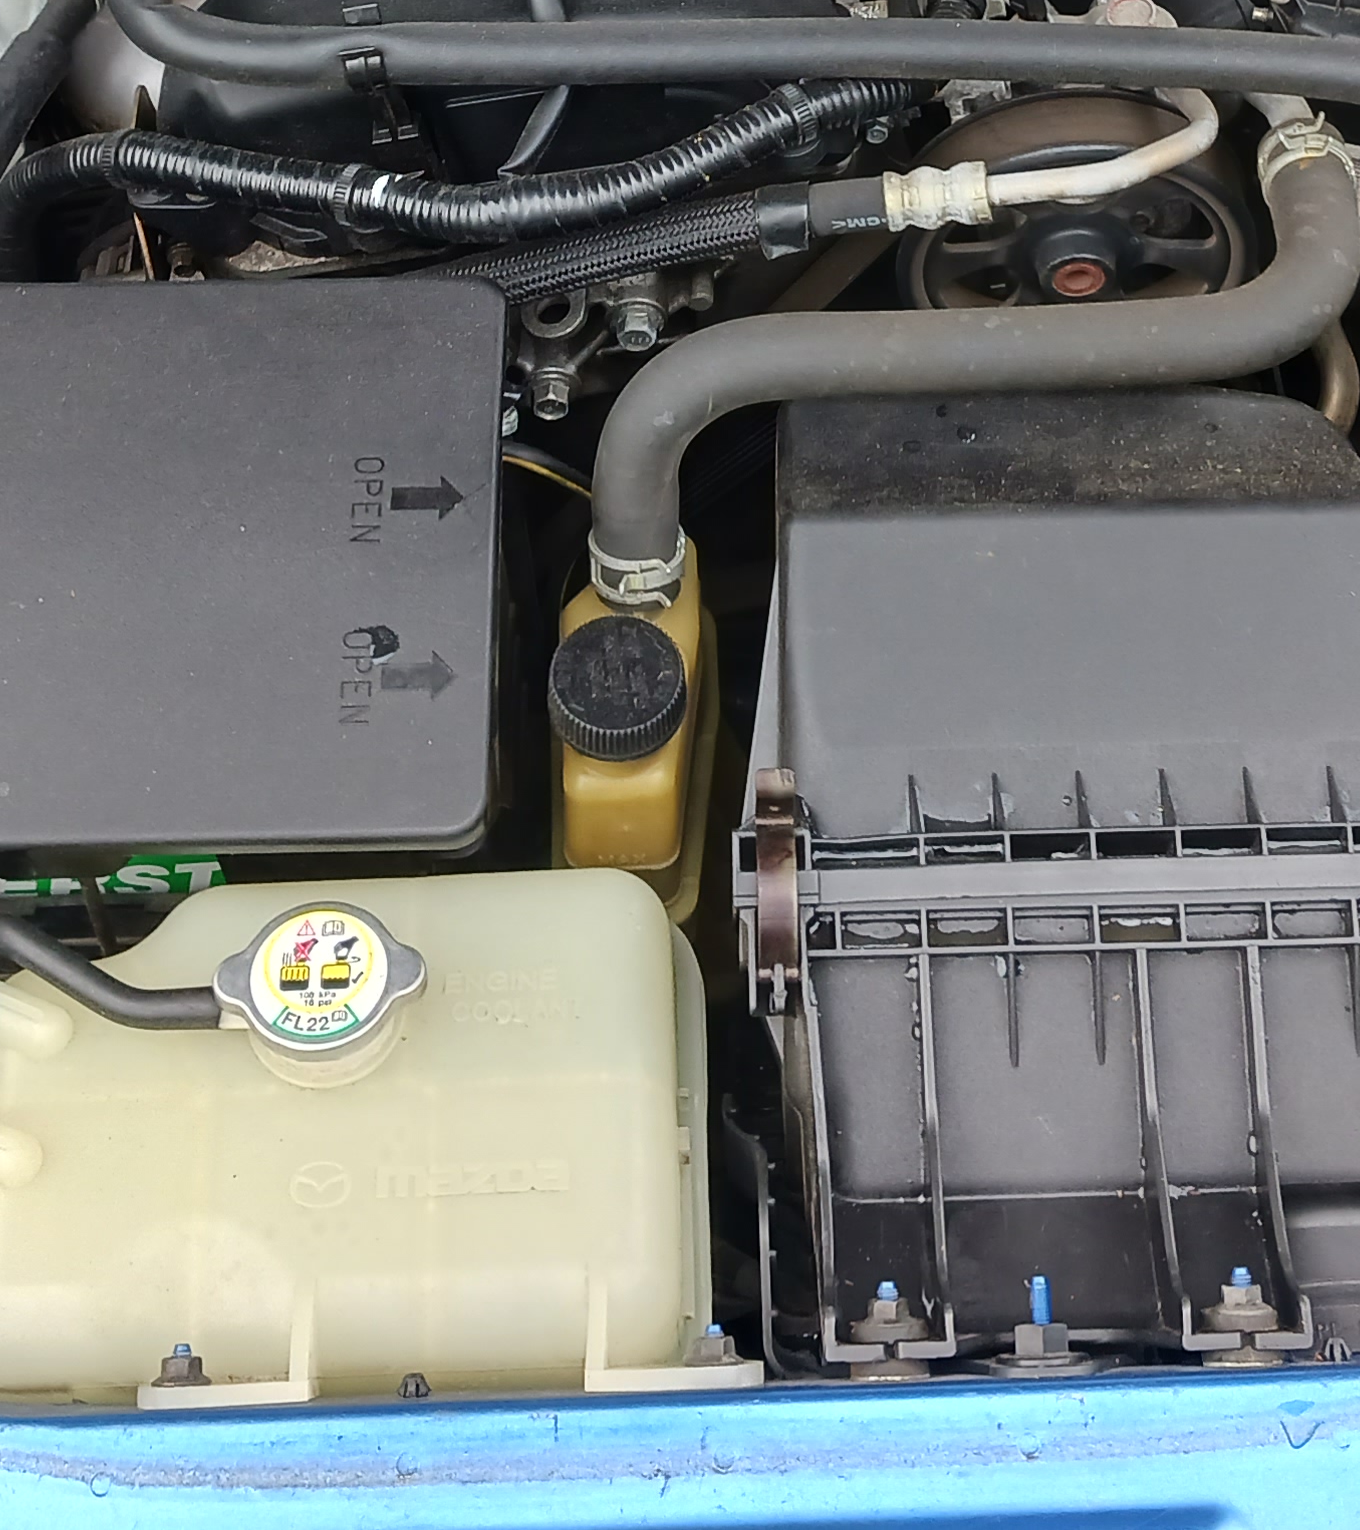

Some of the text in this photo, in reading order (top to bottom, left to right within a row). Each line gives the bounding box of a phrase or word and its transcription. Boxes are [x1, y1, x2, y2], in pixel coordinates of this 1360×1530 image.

[349, 456, 385, 544] OPEN
[338, 630, 373, 727] OPEN
[442, 966, 560, 996] ENGINE
[281, 1011, 331, 1032] FL22
[451, 998, 577, 1025] COOLANT
[375, 1161, 569, 1199] mazda
